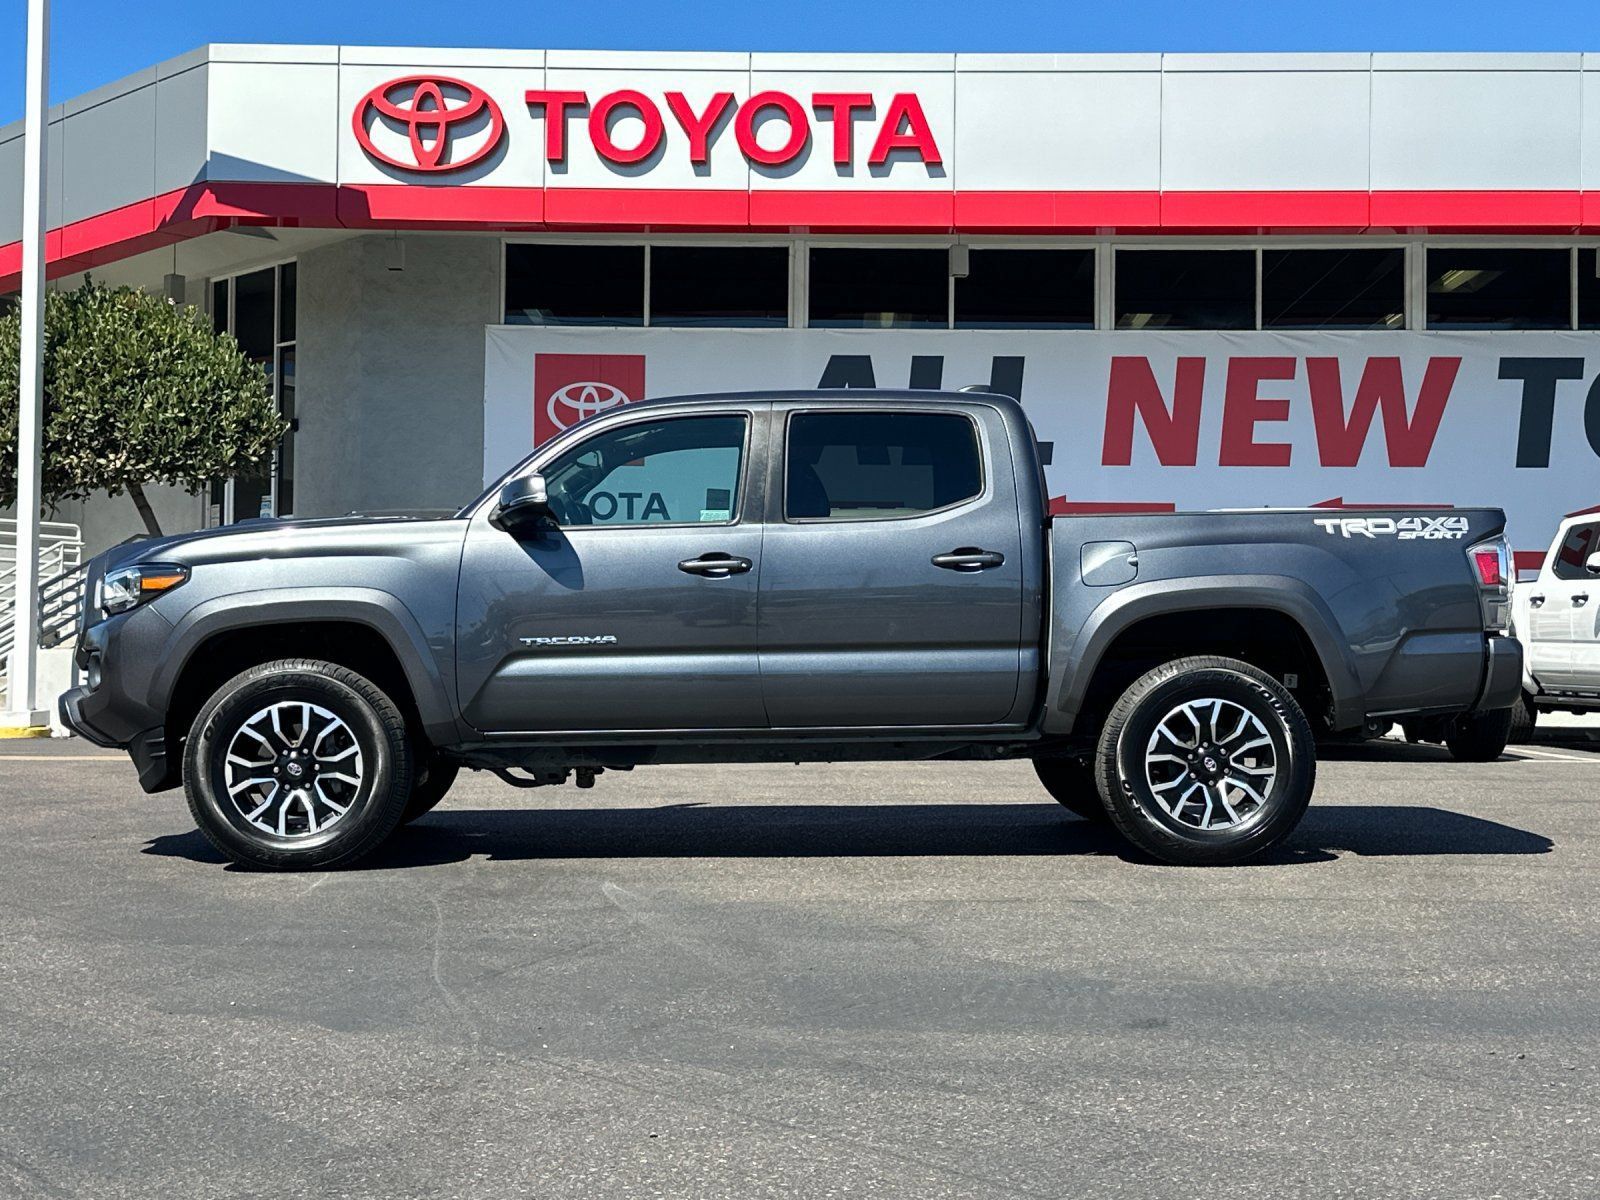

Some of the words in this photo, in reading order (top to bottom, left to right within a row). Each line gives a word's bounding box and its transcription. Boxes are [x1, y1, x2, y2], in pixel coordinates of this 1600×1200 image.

[525, 90, 944, 165] TOYOTA
[1101, 356, 1463, 468] NEW
[1497, 356, 1600, 469] T
[1313, 517, 1397, 539] TRD
[1397, 530, 1468, 540] SPORT
[519, 635, 618, 647] TACOMA
